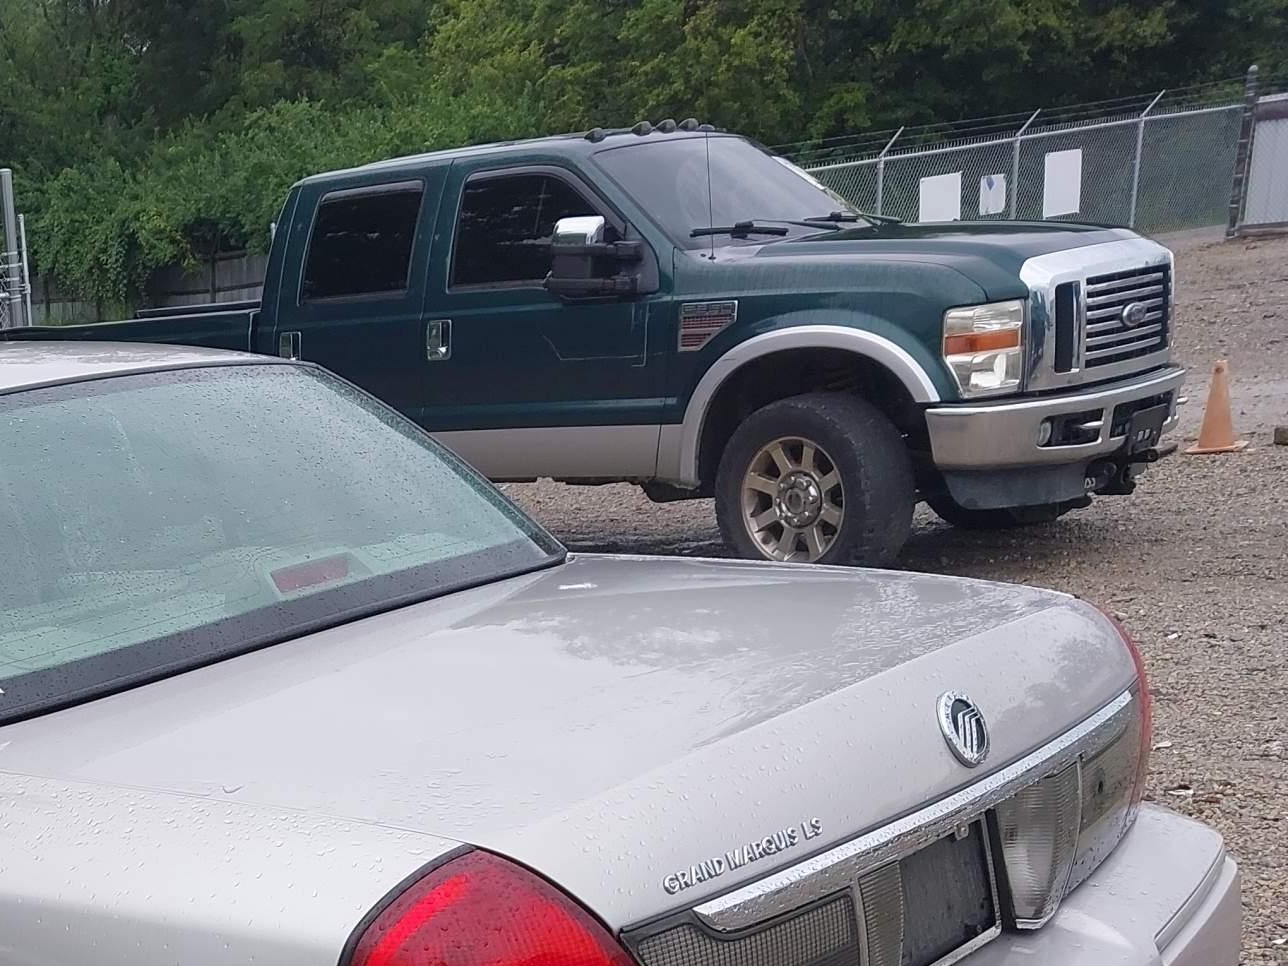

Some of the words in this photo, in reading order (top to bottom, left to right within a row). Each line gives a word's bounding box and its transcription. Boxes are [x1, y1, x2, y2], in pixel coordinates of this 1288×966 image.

[663, 857, 725, 895] GRAND
[725, 827, 799, 871] MARQUIS
[801, 817, 823, 840] LS
